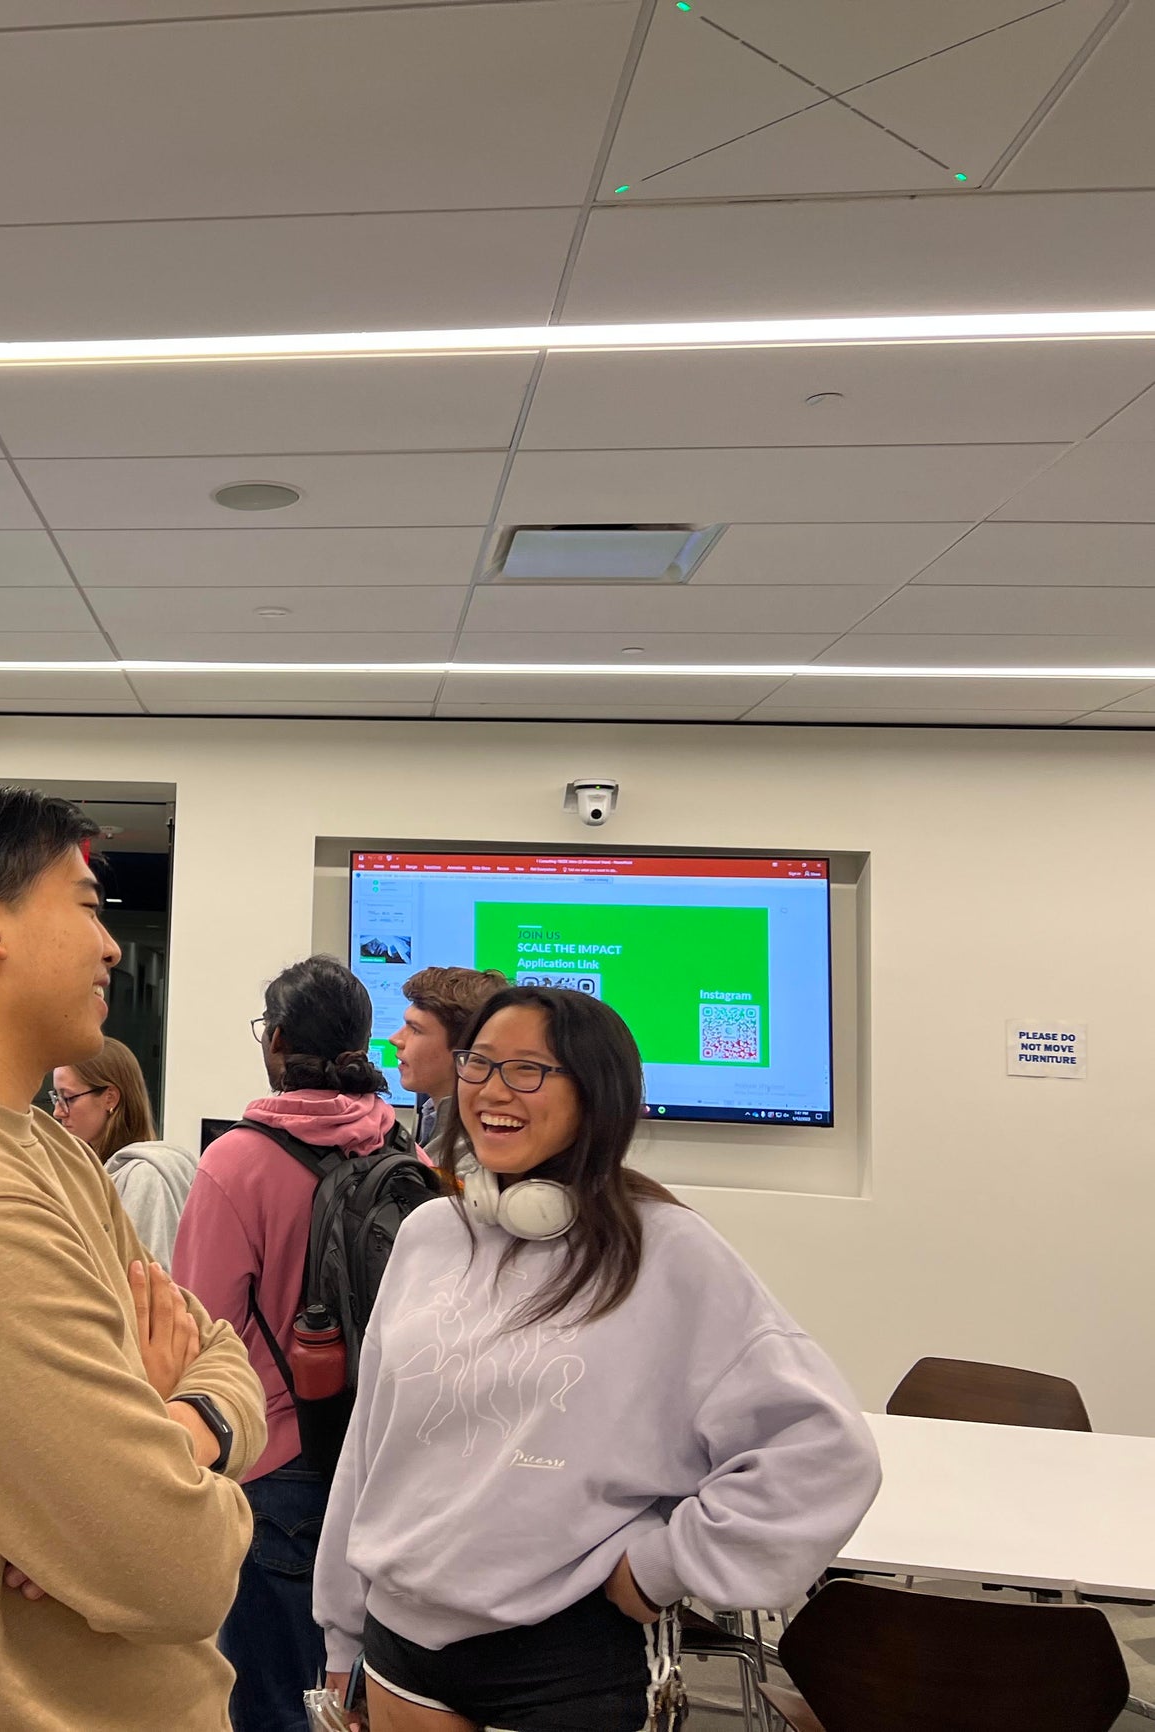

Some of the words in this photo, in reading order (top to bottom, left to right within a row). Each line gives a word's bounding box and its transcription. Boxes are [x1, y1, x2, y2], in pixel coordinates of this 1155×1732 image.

[518, 930, 543, 940] JOIN
[546, 931, 560, 940] US
[517, 943, 551, 953] SCALE
[553, 943, 576, 954] THE
[578, 944, 622, 955] IMPACT
[517, 958, 575, 969] Application
[577, 959, 599, 969] Link
[700, 989, 752, 1001] Instagram
[1019, 1031, 1058, 1041] PLEASE
[1021, 1043, 1041, 1051] NOT
[1044, 1044, 1074, 1053] MOVE
[1018, 1054, 1077, 1064] FURNITURE
